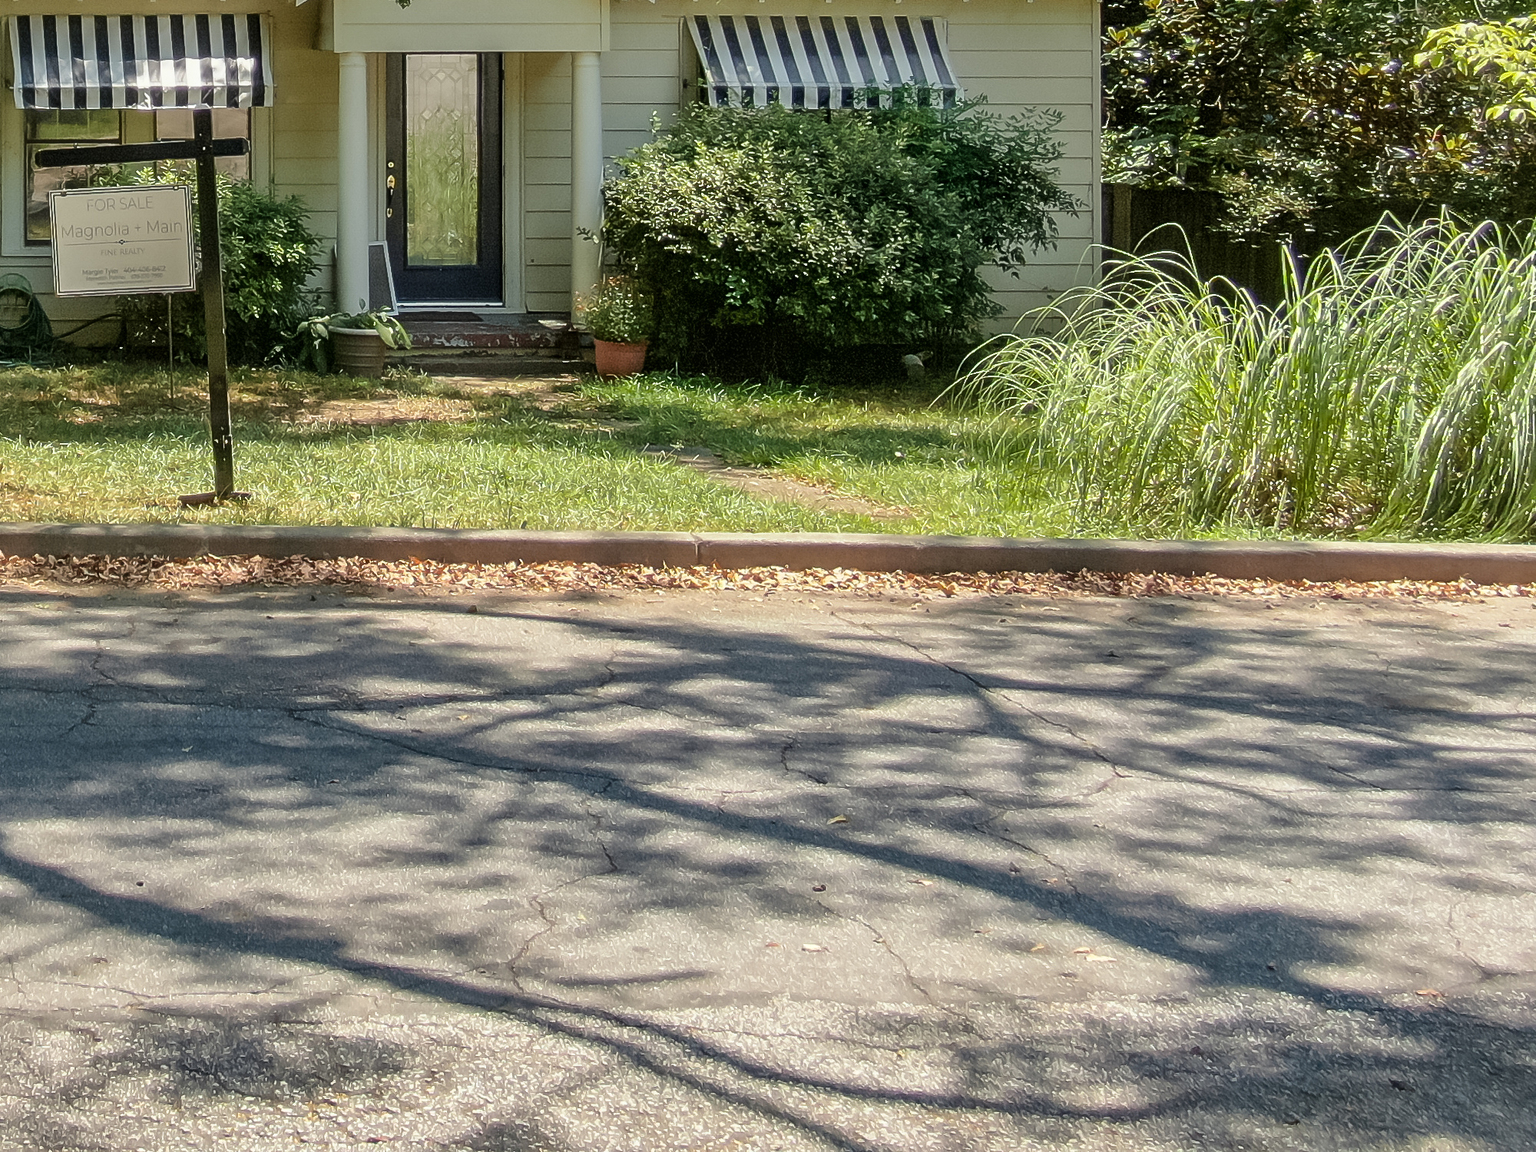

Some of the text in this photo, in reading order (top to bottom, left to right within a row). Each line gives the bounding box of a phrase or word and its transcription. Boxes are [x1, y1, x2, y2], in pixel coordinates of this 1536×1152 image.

[86, 195, 154, 212] FOR SALE
[61, 219, 183, 241] Magnolia + Main
[120, 247, 145, 256] REALTY
